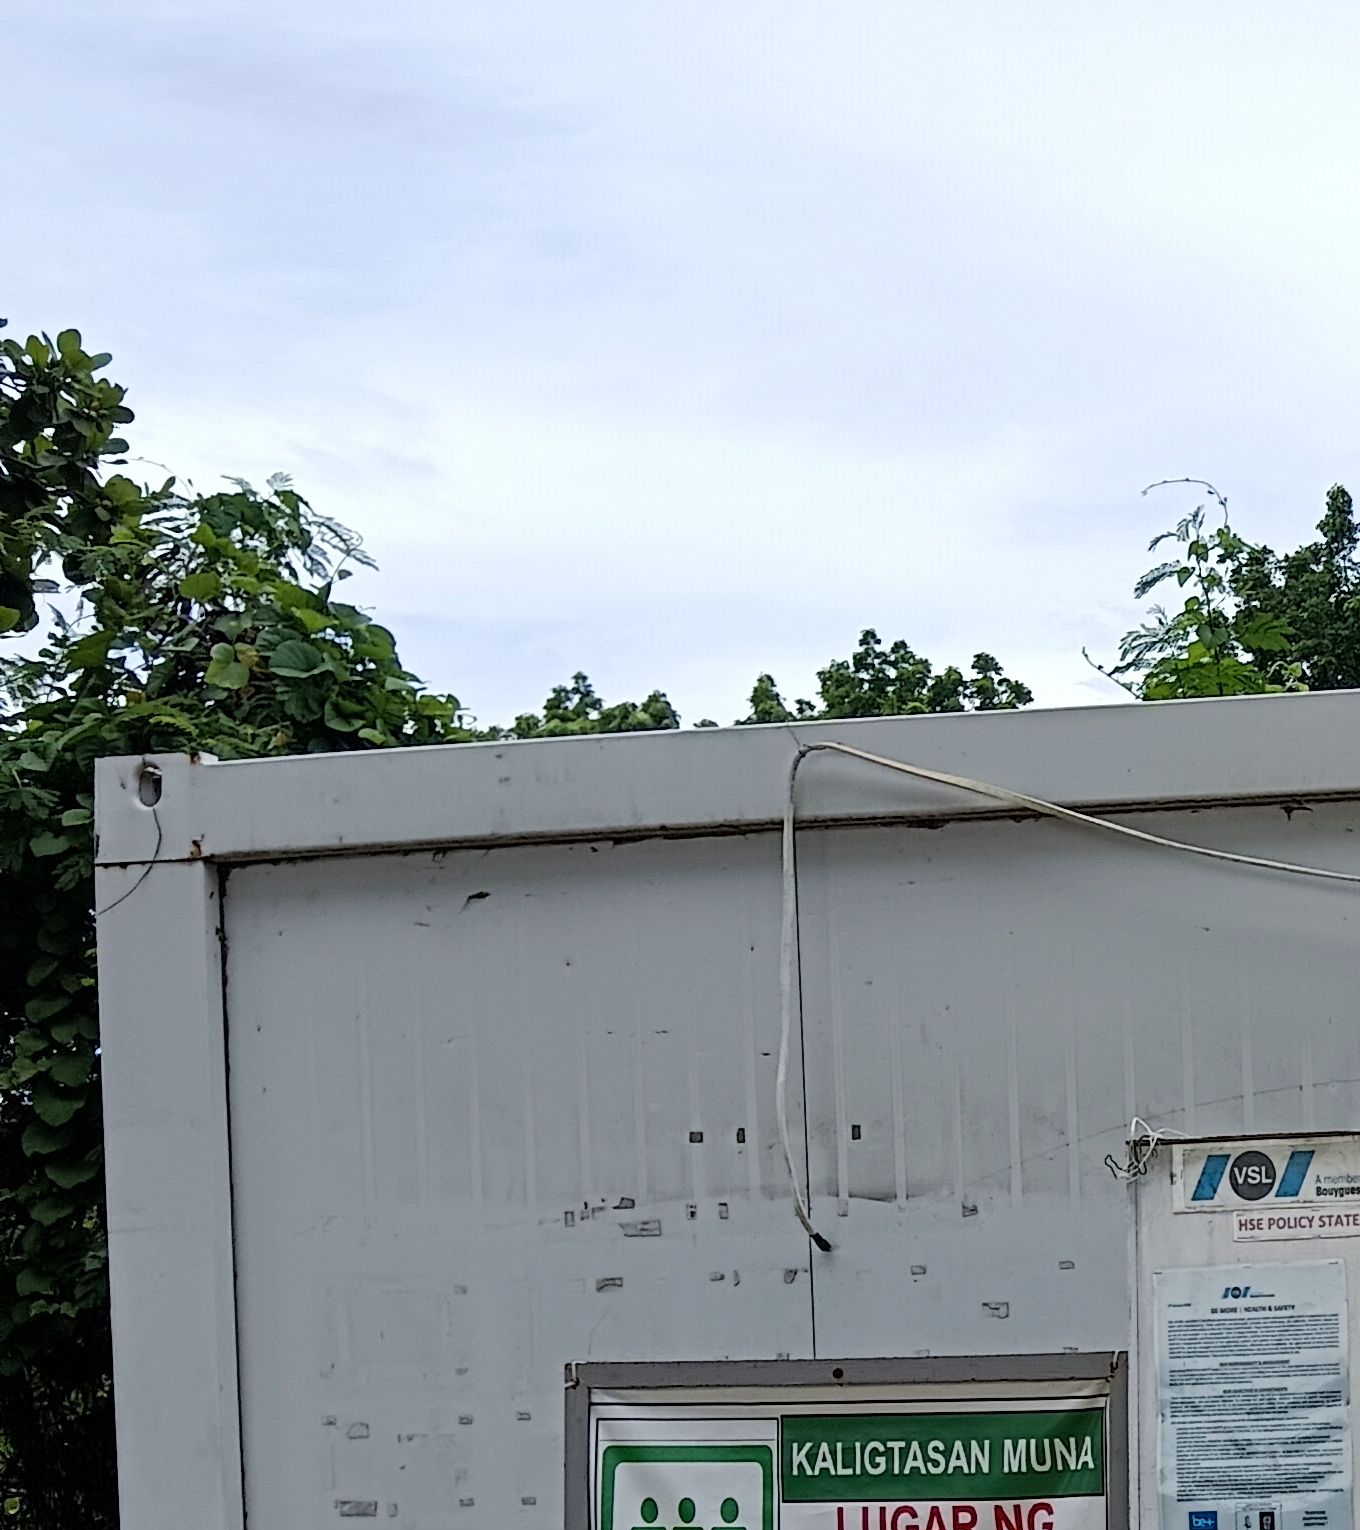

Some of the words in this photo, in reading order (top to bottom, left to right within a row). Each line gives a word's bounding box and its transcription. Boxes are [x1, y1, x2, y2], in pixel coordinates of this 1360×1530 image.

[1233, 1167, 1273, 1184] VSL
[1315, 1175, 1322, 1184] A
[1324, 1173, 1360, 1184] member
[1239, 1218, 1265, 1232] HSE
[1268, 1216, 1315, 1230] POLICY
[791, 1439, 990, 1476] KALIGTASAN
[1003, 1436, 1095, 1474] MUNA
